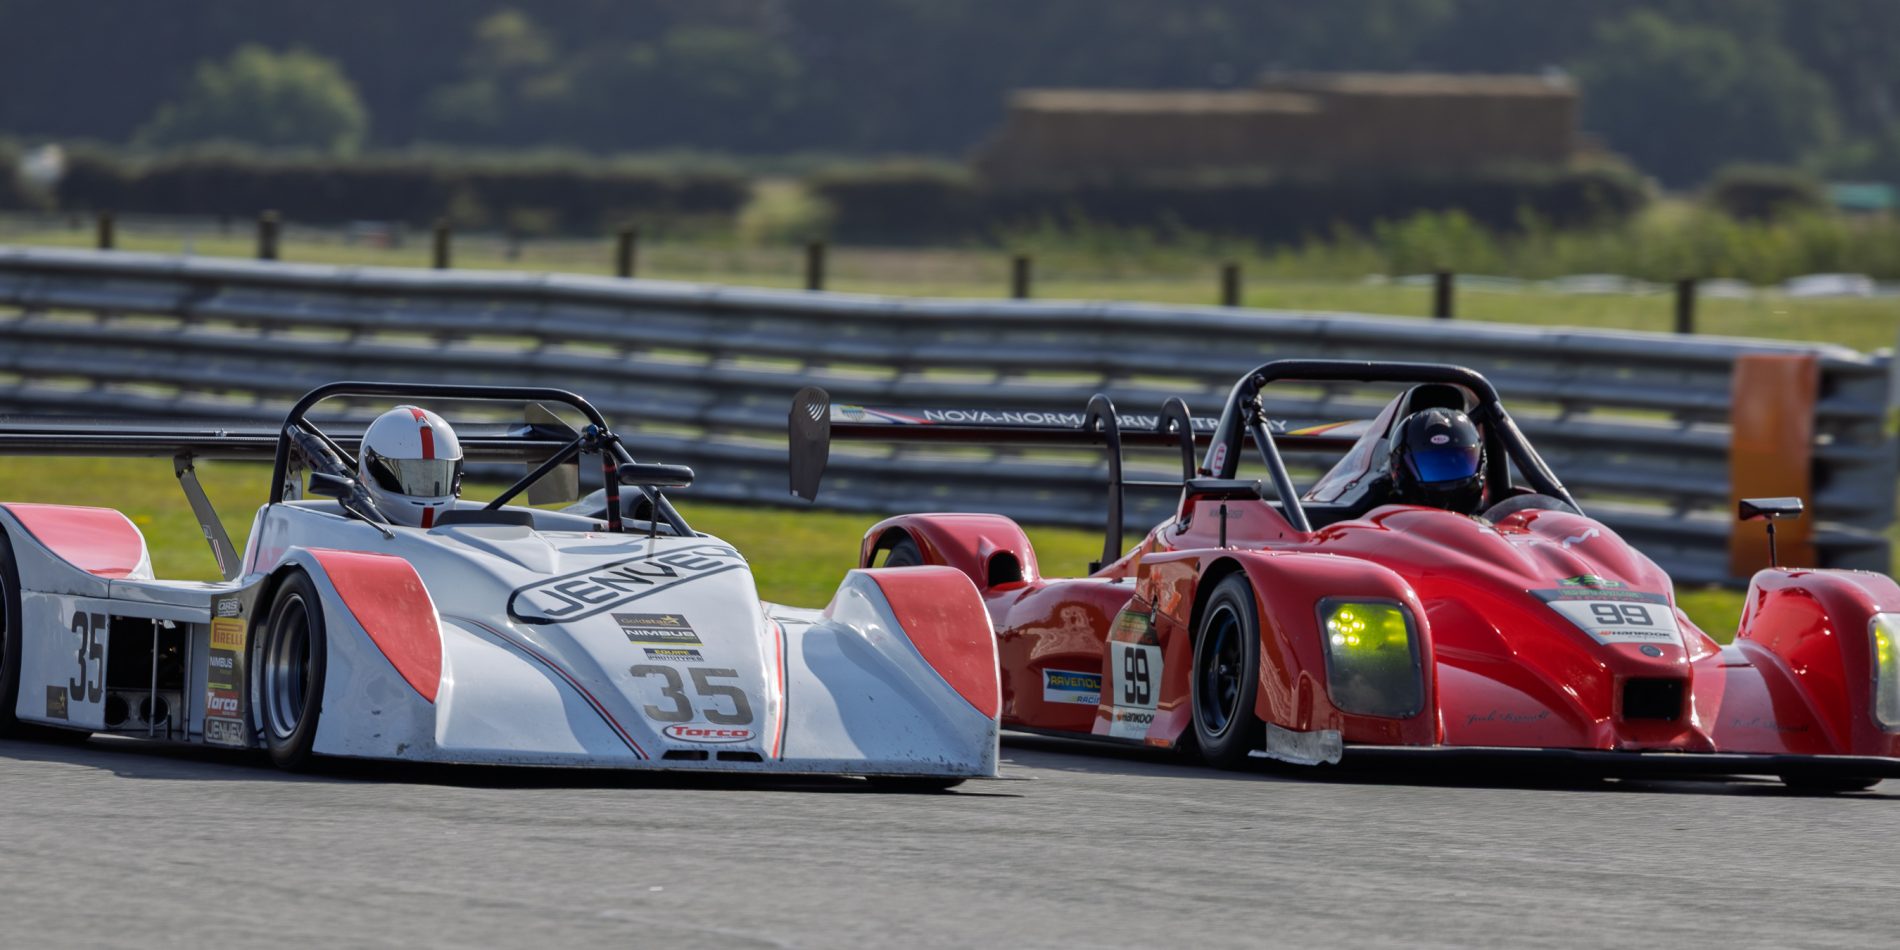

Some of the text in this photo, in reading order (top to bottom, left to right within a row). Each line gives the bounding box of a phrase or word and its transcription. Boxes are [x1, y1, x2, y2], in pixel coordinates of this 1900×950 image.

[538, 547, 746, 616] JENVEY
[1590, 603, 1653, 626] 99
[213, 622, 243, 647] PIRELLI
[625, 629, 696, 637] NIMBUS
[70, 611, 106, 704] 35
[1124, 647, 1150, 705] 99
[207, 691, 238, 711] Torco
[629, 664, 753, 725] 35
[673, 726, 749, 737] Torco
